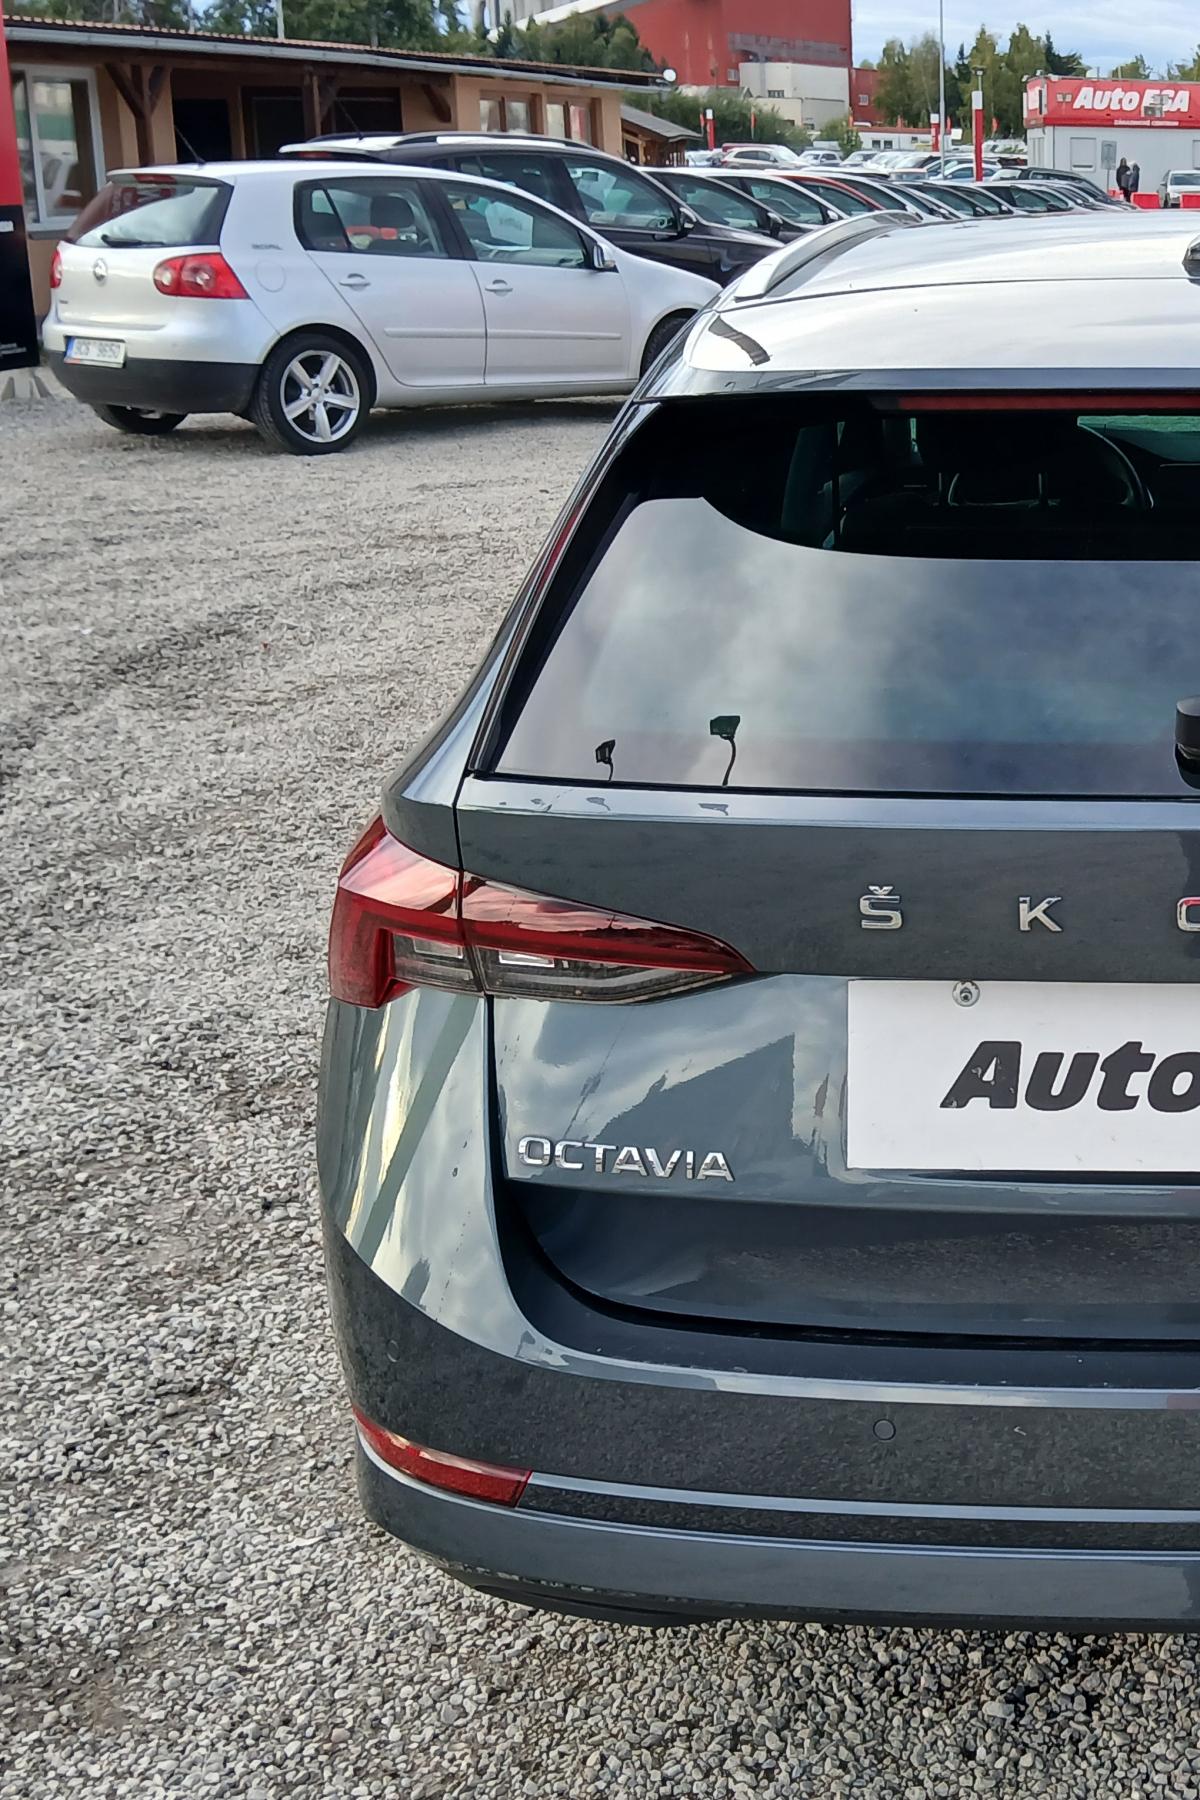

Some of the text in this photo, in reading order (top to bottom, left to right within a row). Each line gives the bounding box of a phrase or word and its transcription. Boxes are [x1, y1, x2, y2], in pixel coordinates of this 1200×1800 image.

[1073, 86, 1191, 113] Auto ESA
[517, 1136, 734, 1181] OCTAVIA
